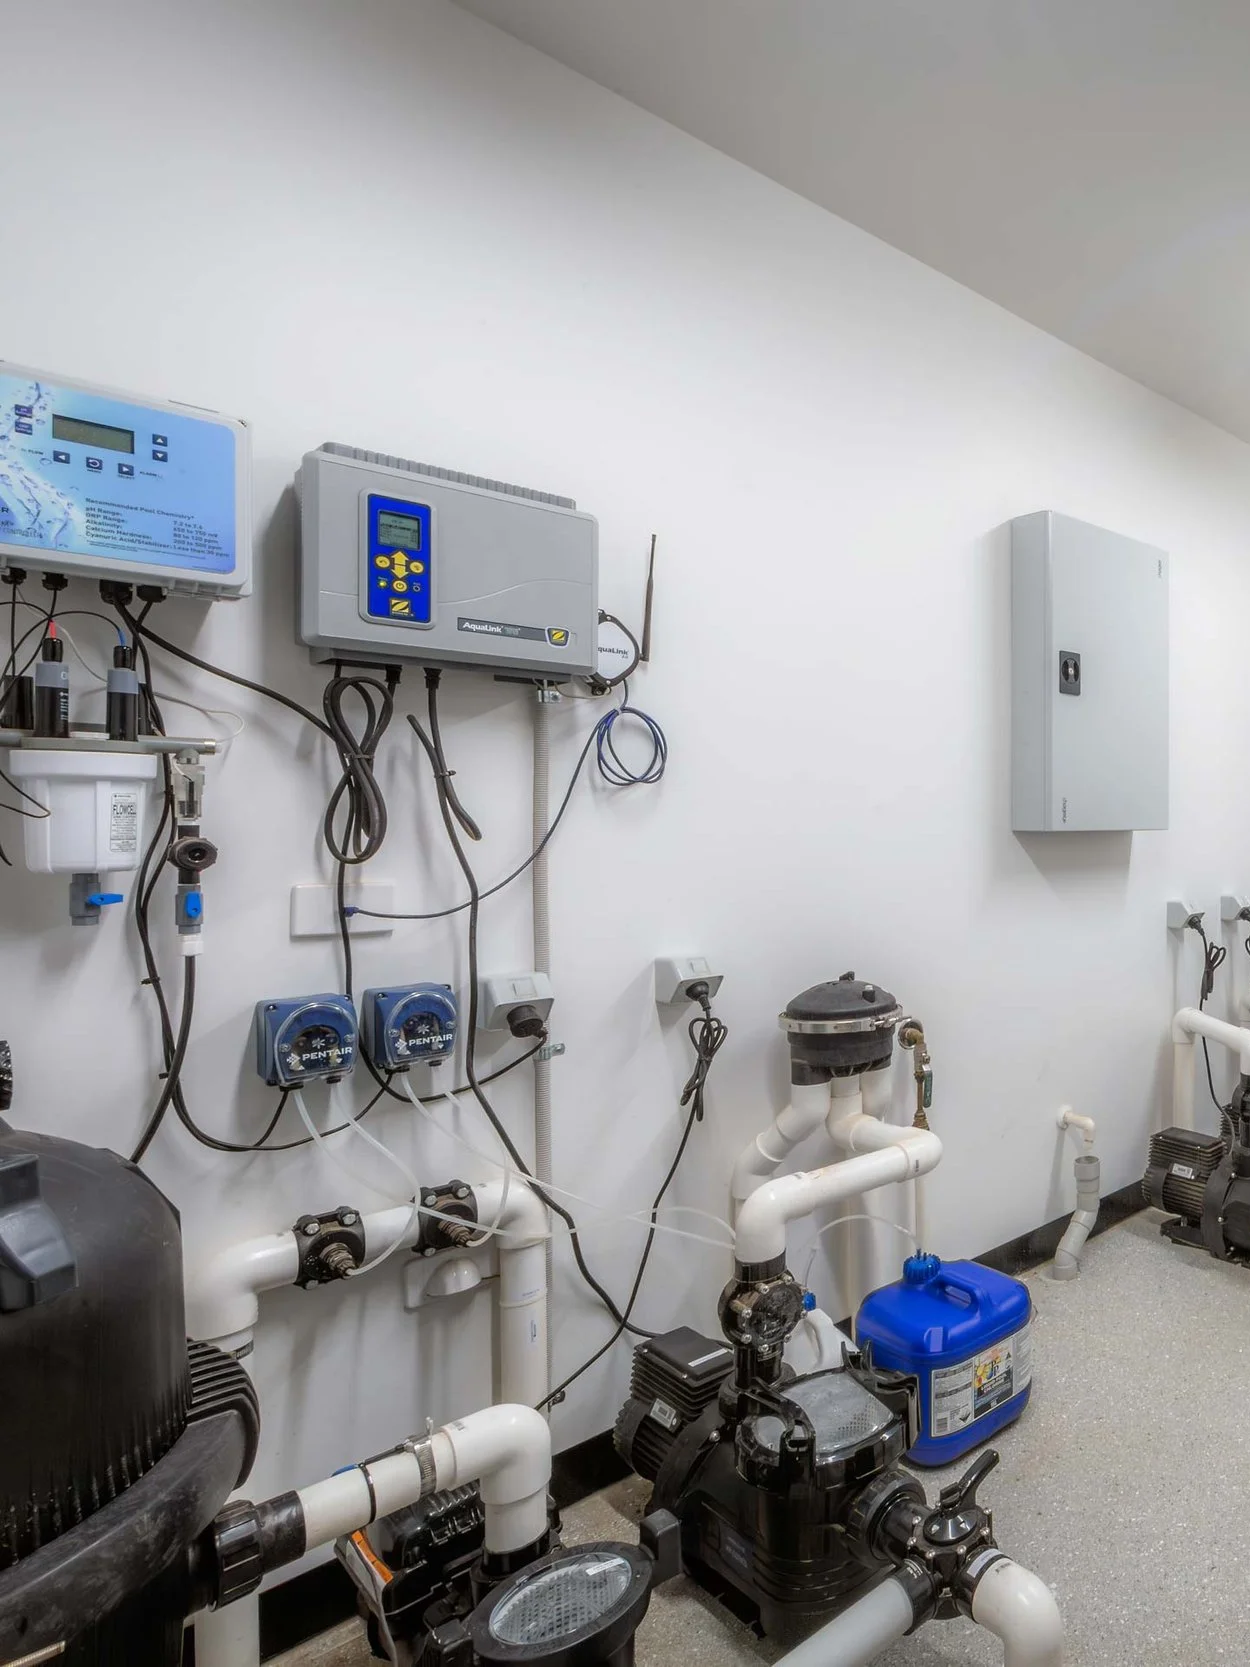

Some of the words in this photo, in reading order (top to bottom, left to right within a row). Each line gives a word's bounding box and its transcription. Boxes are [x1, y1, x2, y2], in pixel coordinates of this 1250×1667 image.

[85, 497, 138, 511] Recommended
[463, 622, 502, 633] AquaLink
[597, 647, 629, 656] quaLink
[408, 1033, 453, 1046] PENTAIR
[302, 1046, 353, 1061] PENTAIR
